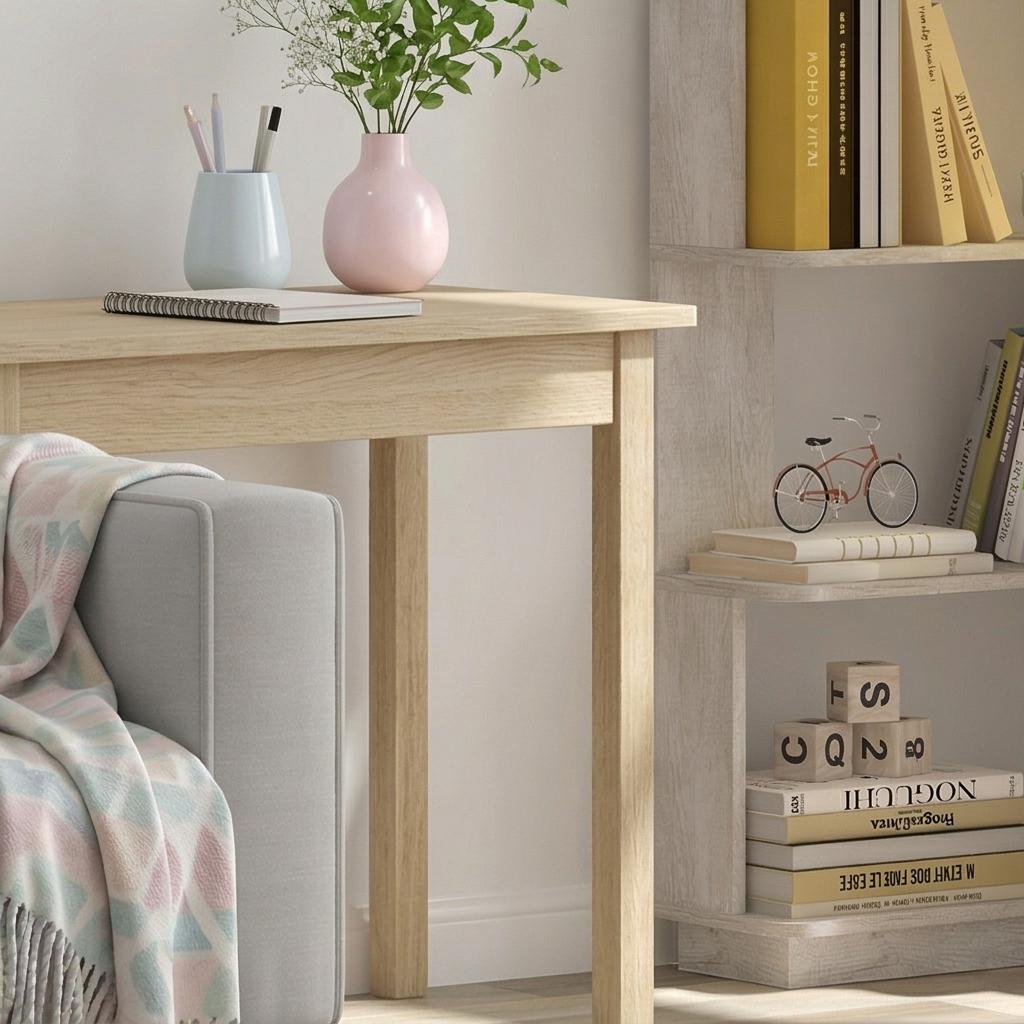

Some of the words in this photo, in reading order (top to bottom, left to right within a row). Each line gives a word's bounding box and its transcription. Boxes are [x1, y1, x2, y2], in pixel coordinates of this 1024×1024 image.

[830, 680, 845, 705] T
[860, 681, 891, 709] S
[780, 736, 808, 765] C
[824, 733, 846, 768] Q
[861, 737, 888, 761] 2
[844, 779, 977, 811] NOGUCHI
